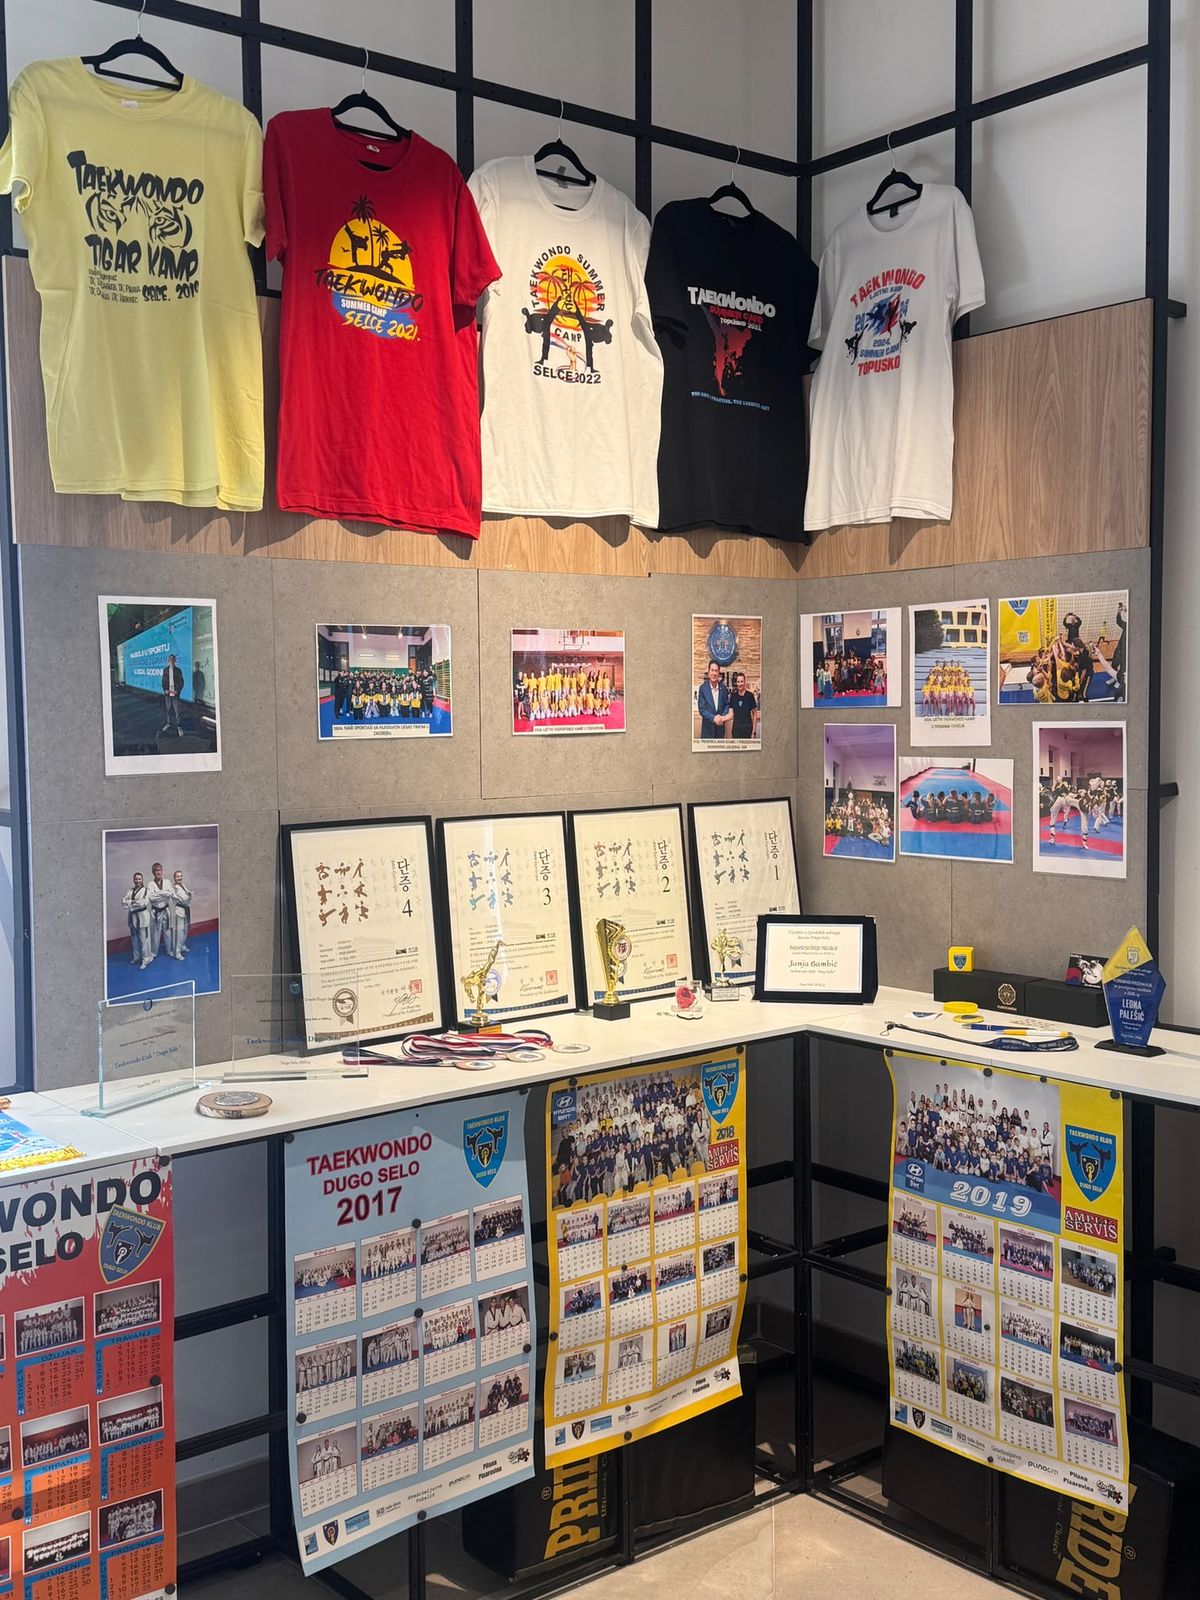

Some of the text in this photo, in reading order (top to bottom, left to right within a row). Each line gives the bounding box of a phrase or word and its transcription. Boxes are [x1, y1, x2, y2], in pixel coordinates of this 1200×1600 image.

[67, 150, 204, 205] TAEKWONDO
[85, 234, 199, 281] TIGAR KAMP
[530, 245, 571, 308] TAEKWONDO
[577, 254, 606, 312] SUMMER
[314, 269, 423, 312] TAEKWONDO
[341, 298, 387, 317] SUMMER CAMP
[688, 286, 776, 318] TAEKWONDO
[343, 311, 385, 333] SELCE
[555, 328, 582, 343] CAMP
[859, 349, 885, 358] SUMMER
[533, 365, 602, 384] SELCE 2022
[858, 355, 900, 376] TOPUSKO
[661, 876, 670, 893] 2
[543, 887, 552, 906] 3
[401, 899, 413, 918] 4
[788, 960, 809, 968] Janja
[1122, 998, 1142, 1010] LEONA
[1119, 1009, 1145, 1021] PALEŠIĆ
[716, 1127, 735, 1140] 2018
[1069, 1128, 1113, 1145] TAEKWONDO KLUB
[306, 1132, 433, 1176] TAEKWONDO
[708, 1151, 739, 1171] SERVIS
[322, 1161, 420, 1196] DUGO SELO
[336, 1185, 403, 1227] 2017
[950, 1181, 1033, 1217] 2019
[111, 1209, 162, 1231] TAEKWONDO KLUB
[1065, 1219, 1118, 1240] SERVIS
[111, 1329, 150, 1344] TRAVANJ
[114, 1436, 153, 1451] KOLOVOZ
[956, 1431, 967, 1441] ND
[42, 1457, 79, 1473] SRPANJ
[1063, 1477, 1094, 1493] Pisarovina
[1069, 1471, 1088, 1482] Pilana
[110, 1538, 155, 1556] PROSINAC
[1056, 1483, 1137, 1600] RIDE
[40, 1562, 81, 1579] STUDENI
